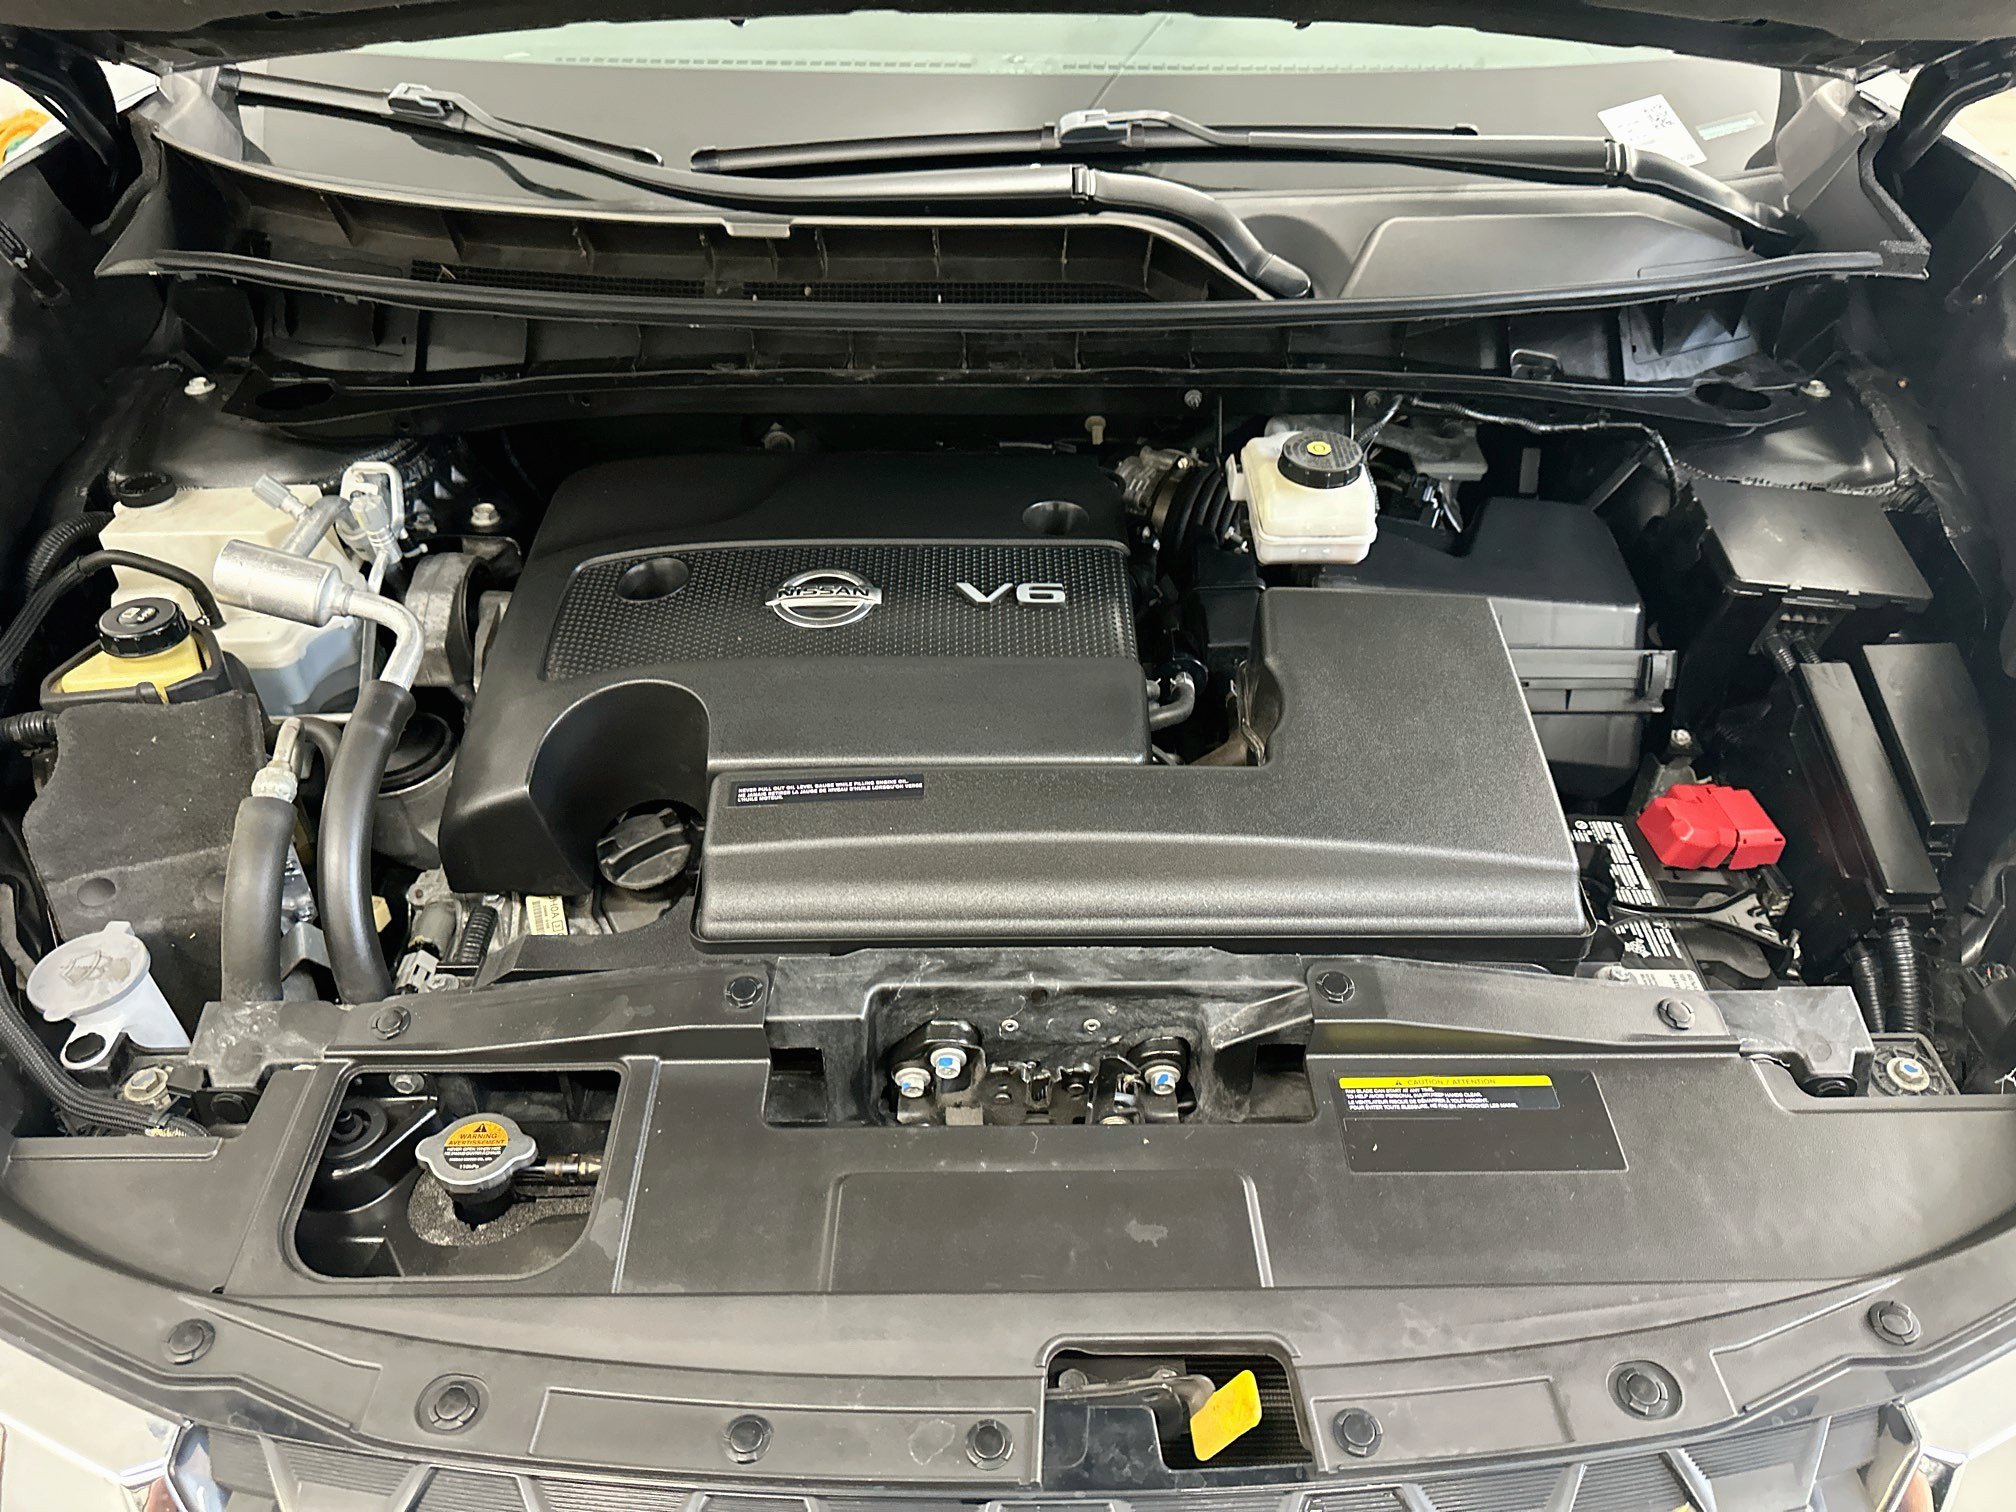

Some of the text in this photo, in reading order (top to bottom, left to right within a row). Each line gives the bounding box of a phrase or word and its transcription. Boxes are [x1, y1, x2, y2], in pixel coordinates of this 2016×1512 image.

[777, 586, 870, 597] NISSAN
[955, 582, 1067, 609] V6
[1407, 1078, 1443, 1086] CAUTION
